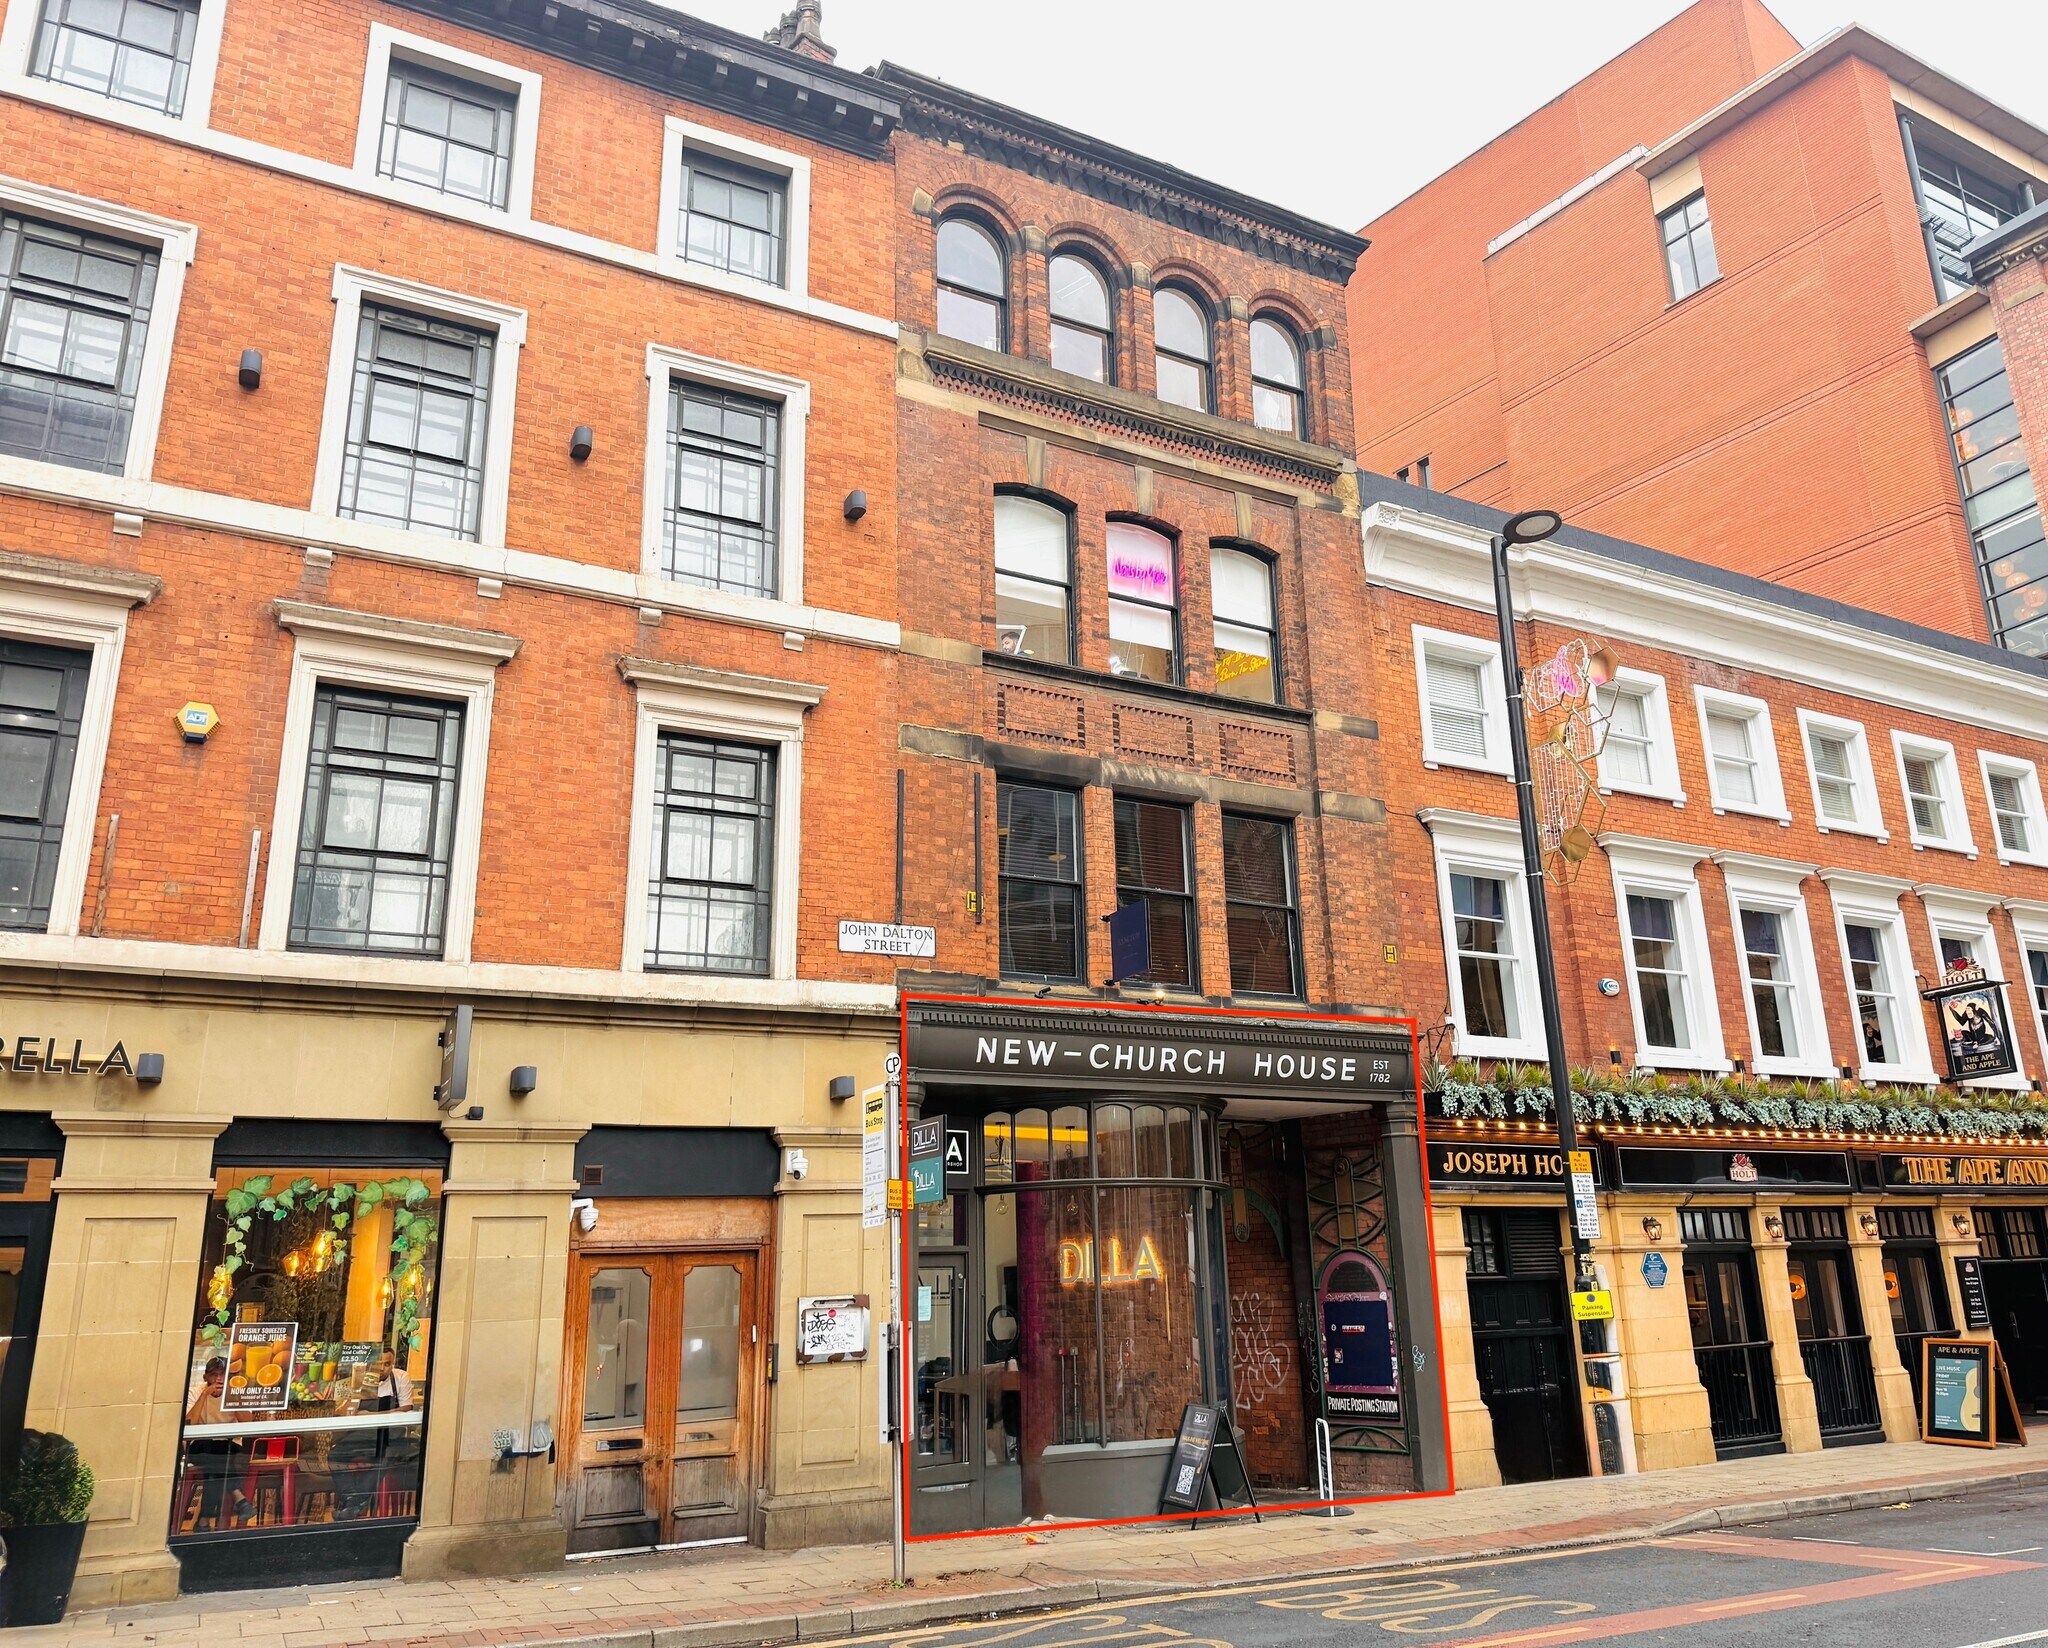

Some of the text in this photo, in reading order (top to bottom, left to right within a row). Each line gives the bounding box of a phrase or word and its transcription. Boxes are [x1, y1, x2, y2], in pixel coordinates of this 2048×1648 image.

[187, 713, 208, 722] ADT
[842, 924, 933, 941] JOHN DALTON
[864, 939, 911, 952] STREET
[1945, 972, 1981, 985] HOLT
[886, 1056, 900, 1074] CP
[1254, 1053, 1357, 1081] HOUSE
[1373, 1060, 1390, 1071] EST
[1962, 1060, 2001, 1071] AND APPLE
[1369, 1072, 1391, 1084] 1782
[874, 1116, 883, 1126] Stop
[913, 1127, 937, 1148] DILLA
[1443, 1152, 1564, 1176] JOSEPH HO
[1902, 1157, 2048, 1185] THE APE AND
[915, 1172, 935, 1188] DILLA
[1732, 1170, 1755, 1178] HOLT
[1060, 1236, 1162, 1283] DILLA
[238, 1333, 287, 1342] ORANGE JUICE
[263, 1386, 281, 1394] £2.50
[1327, 1396, 1398, 1413] PRIVATE POSTING STATION
[1256, 1580, 1596, 1634] BUS
